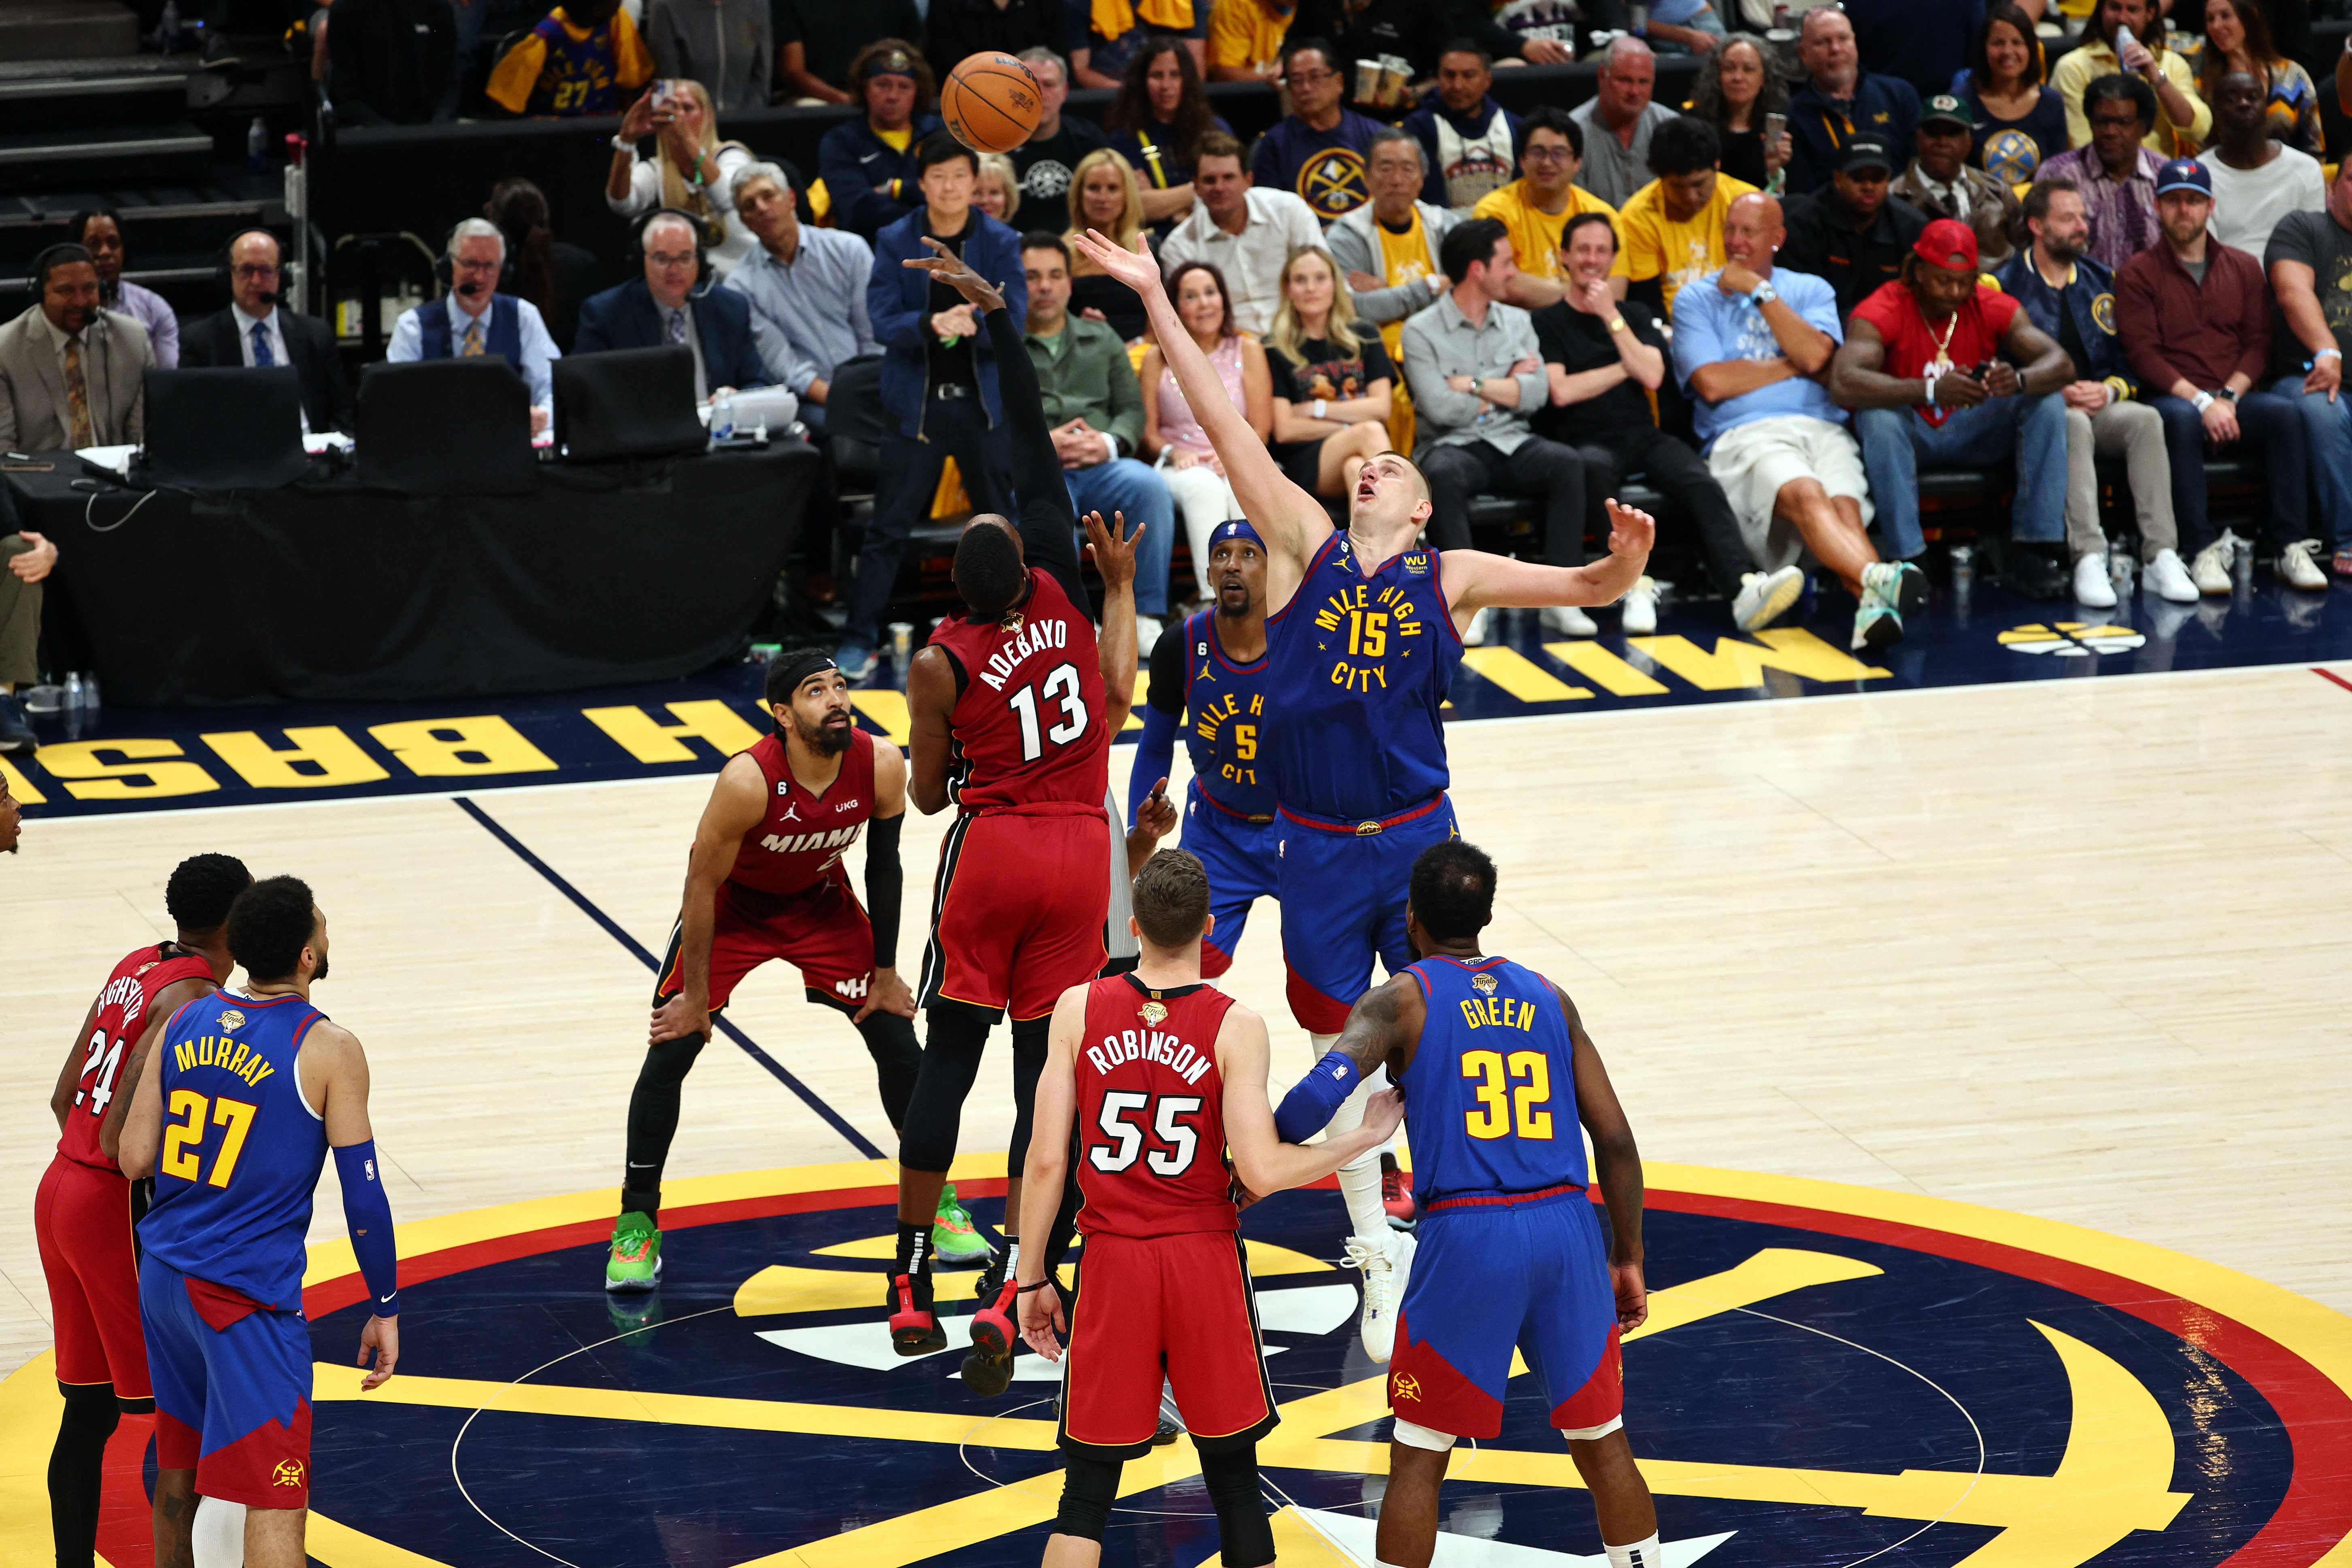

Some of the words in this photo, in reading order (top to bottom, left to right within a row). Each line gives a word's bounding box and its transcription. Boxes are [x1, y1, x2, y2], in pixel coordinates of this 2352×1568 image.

[553, 80, 589, 109] 27
[1341, 540, 1349, 553] 6
[1404, 555, 1427, 565] WU
[1314, 585, 1369, 632] MILE
[1376, 586, 1421, 636] HIGH
[1197, 642, 1207, 656] 6
[1348, 610, 1389, 657] 15
[979, 618, 1066, 691] ADEBAYO
[1331, 661, 1387, 693] CITY
[1009, 661, 1089, 763] 13
[1197, 693, 1240, 741] MILE
[1236, 725, 1257, 760] 5
[777, 781, 787, 795] 6
[1221, 763, 1257, 785] CIT
[760, 821, 866, 853] MIAMI
[1473, 976, 1497, 987] Finals
[217, 1011, 245, 1024] Finals
[1138, 1004, 1167, 1016] Finals
[1459, 997, 1535, 1032] GREEN
[74, 1027, 125, 1117] 24
[174, 1036, 275, 1087] MURRAY
[1086, 1029, 1212, 1086] ROBINSON
[1461, 1049, 1554, 1141] 32
[161, 1088, 258, 1189] 27
[1087, 1089, 1205, 1178] 55
